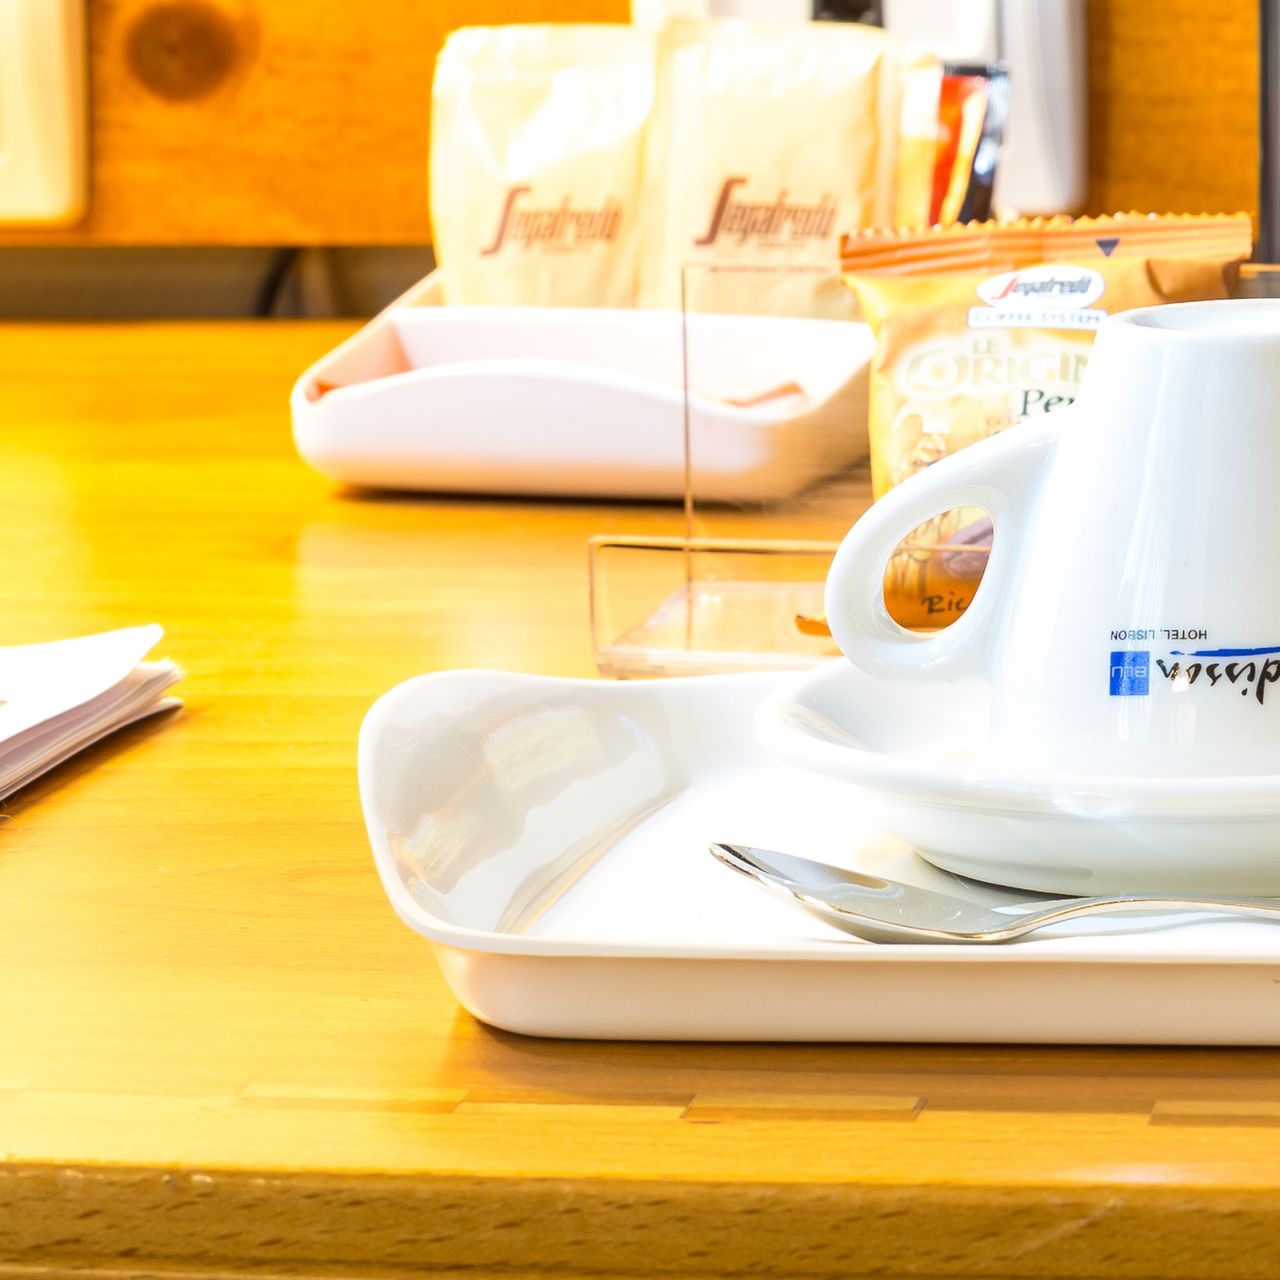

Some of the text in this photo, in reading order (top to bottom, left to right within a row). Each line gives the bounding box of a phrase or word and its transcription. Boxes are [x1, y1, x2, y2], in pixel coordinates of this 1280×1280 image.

[990, 276, 1092, 300] Segafredo
[1110, 629, 1155, 641] LISBON
[1111, 665, 1149, 680] BLU
